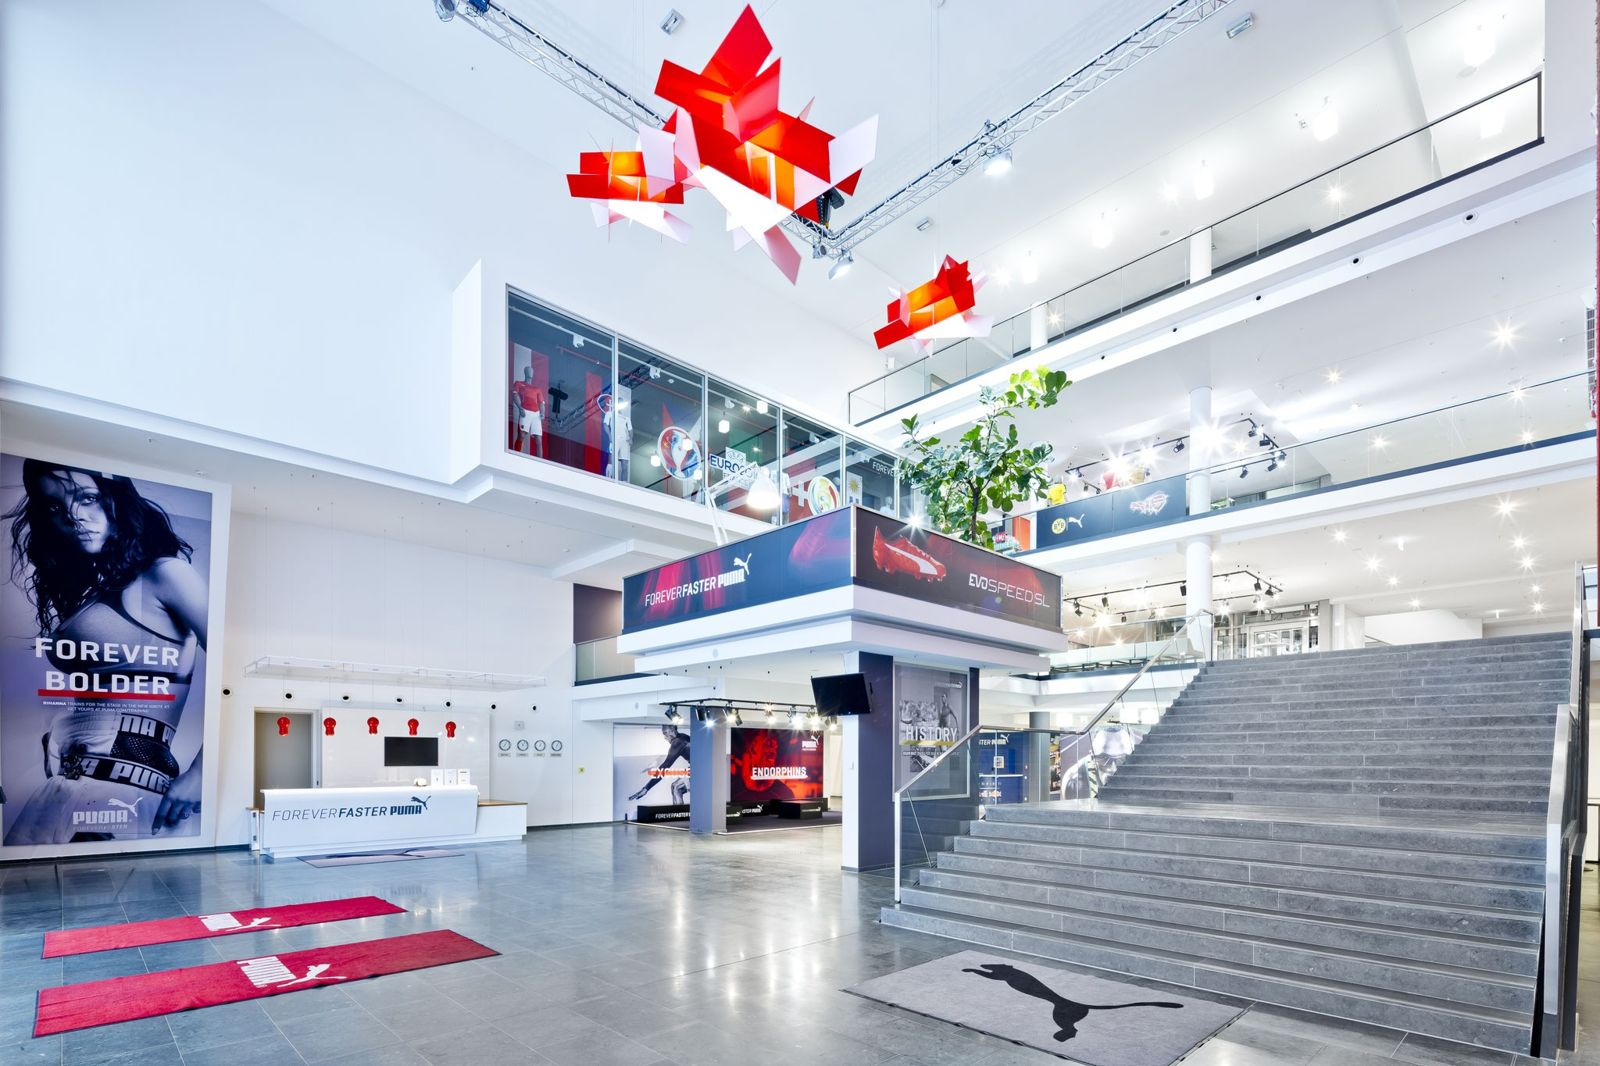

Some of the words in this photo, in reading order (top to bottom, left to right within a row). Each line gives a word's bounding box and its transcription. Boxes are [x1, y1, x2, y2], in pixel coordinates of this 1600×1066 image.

[718, 568, 746, 588] PUMA
[35, 637, 179, 666] FOREVER
[45, 671, 170, 695] BOLDER
[906, 726, 957, 742] HISTORY
[752, 766, 807, 777] ENDORPHINS
[72, 810, 128, 825] PUMA
[389, 804, 423, 816] PUMA
